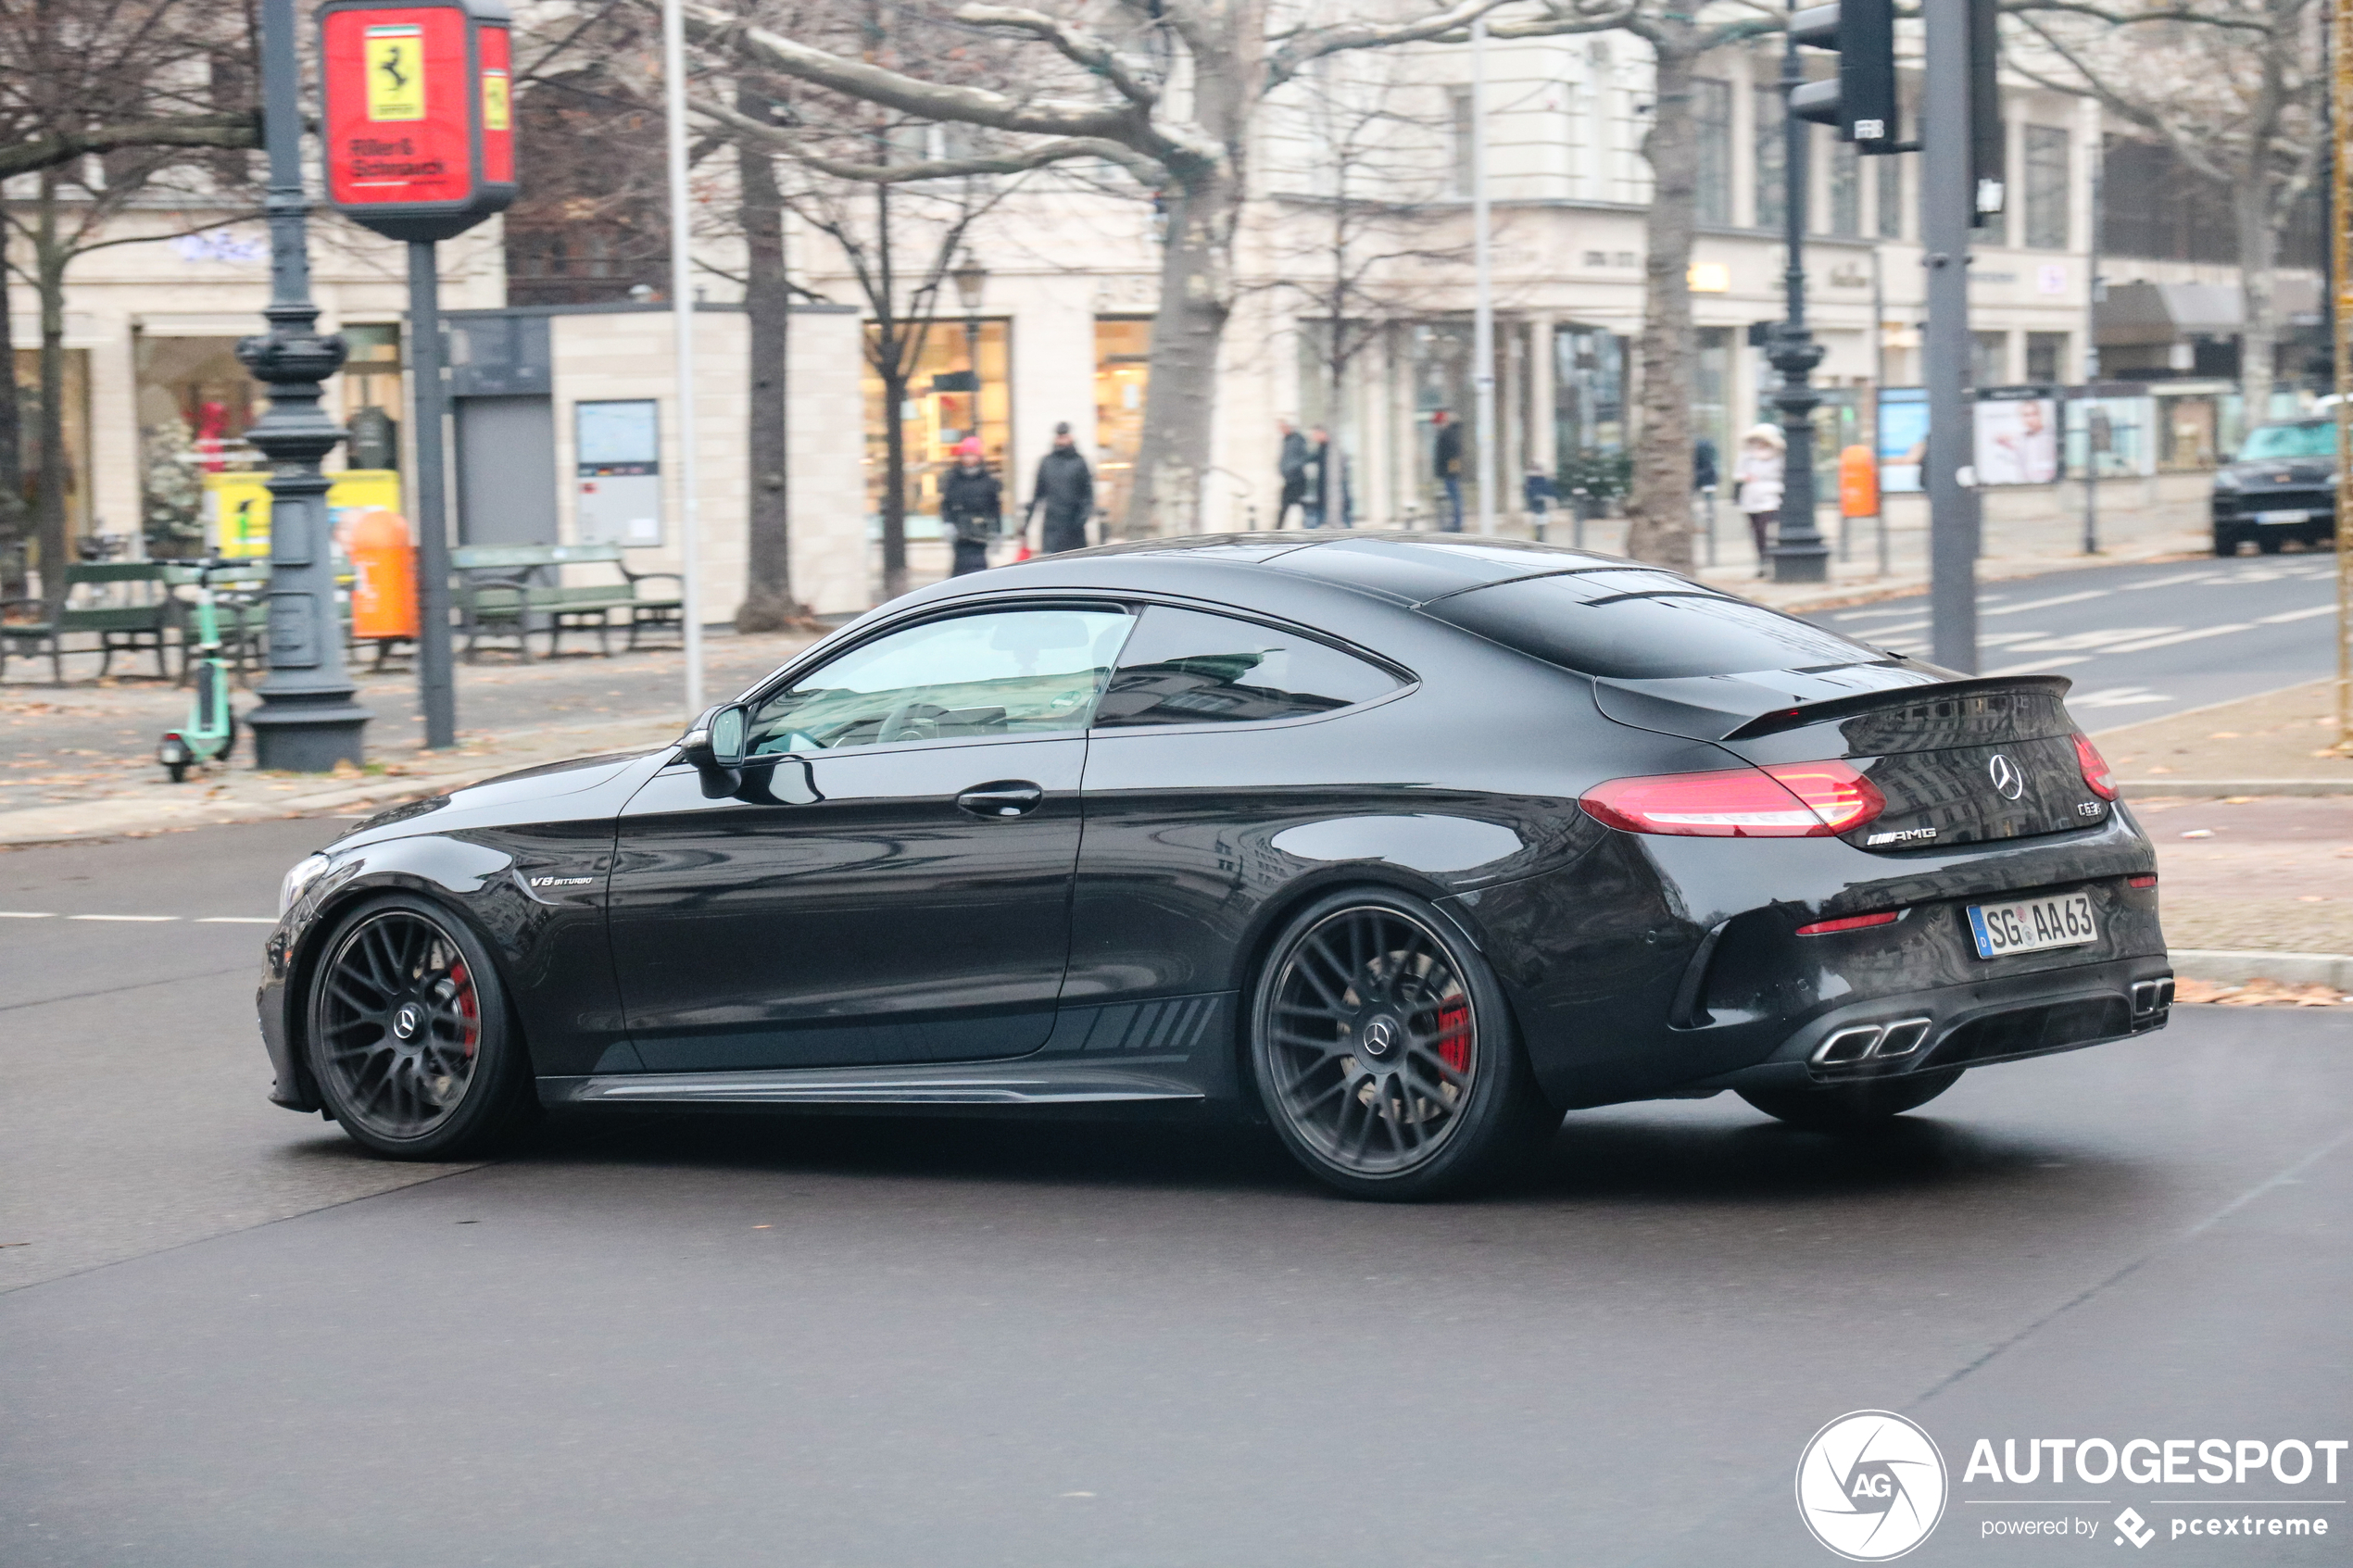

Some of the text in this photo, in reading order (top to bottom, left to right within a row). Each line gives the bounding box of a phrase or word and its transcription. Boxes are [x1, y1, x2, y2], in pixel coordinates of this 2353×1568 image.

[531, 876, 593, 887] V8 BITURBO
[1986, 909, 2023, 948] SG
[1980, 936, 1987, 948] D
